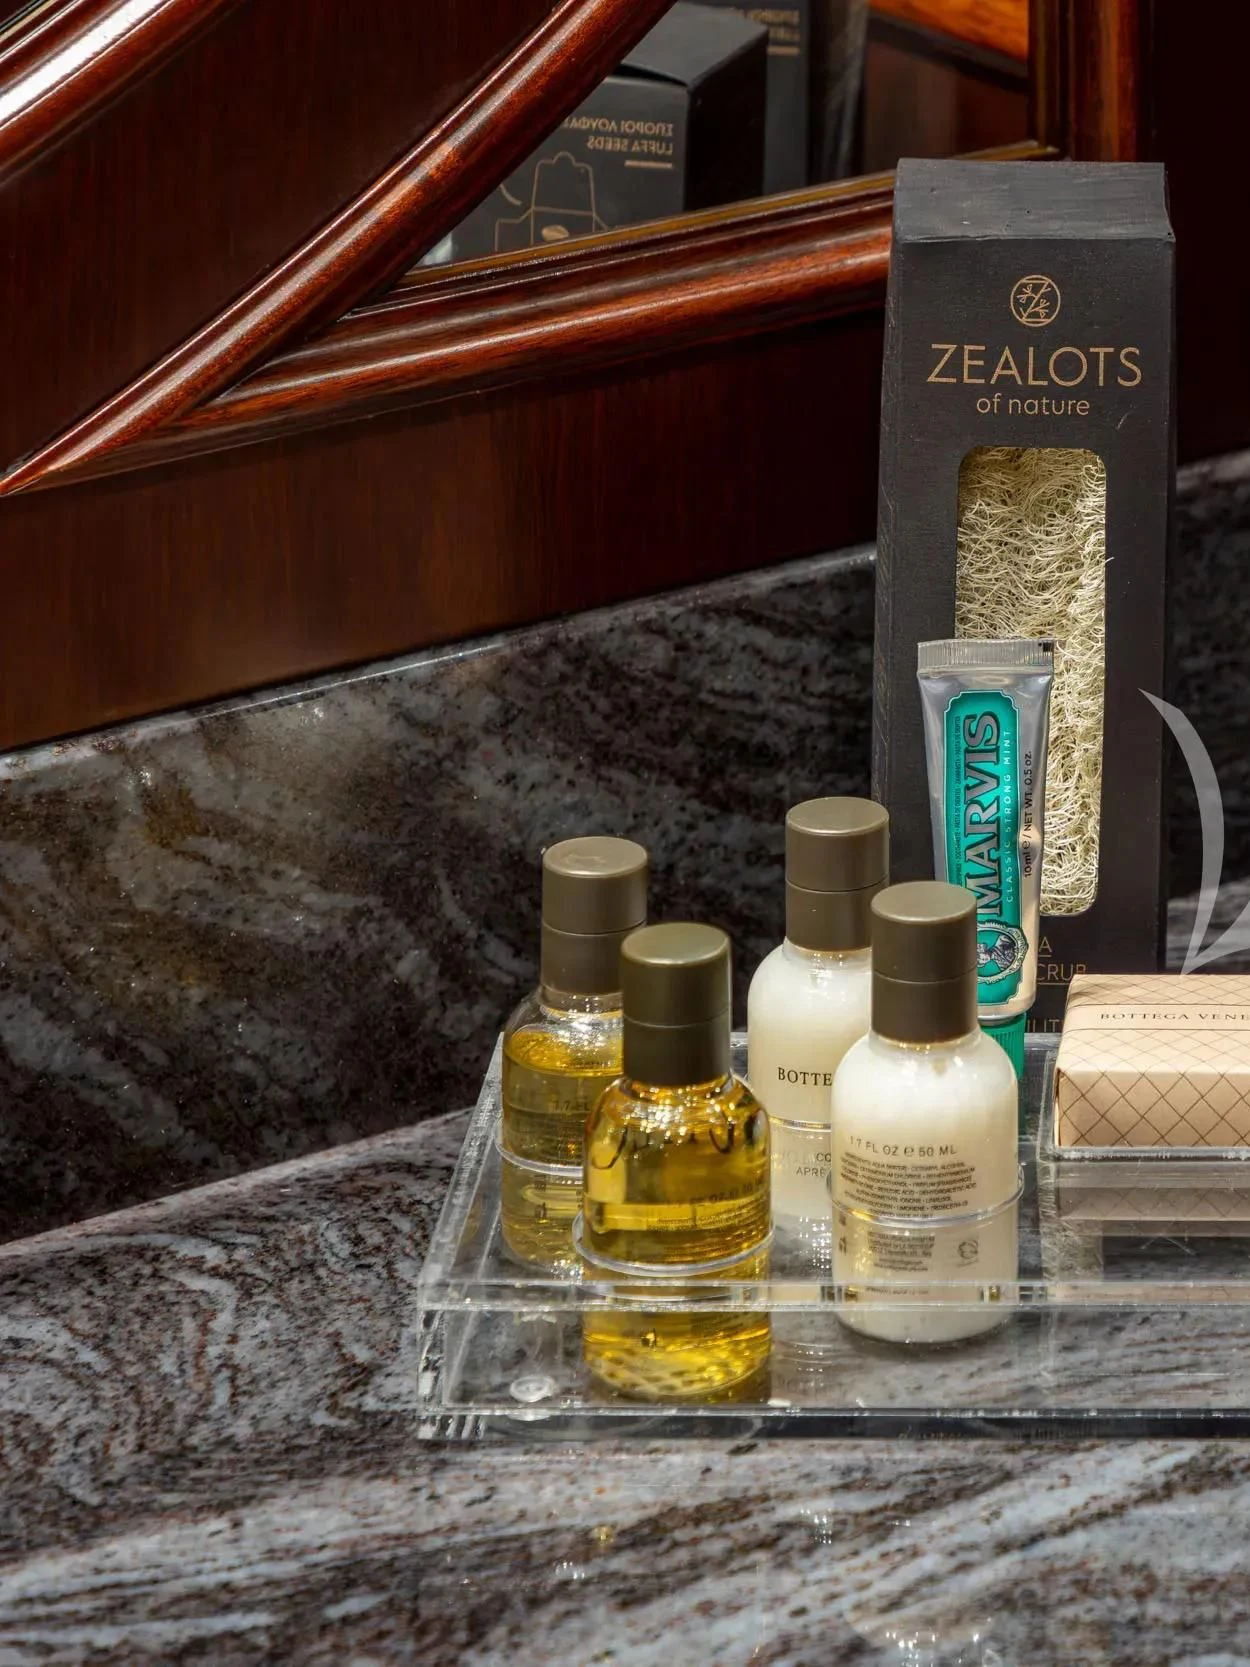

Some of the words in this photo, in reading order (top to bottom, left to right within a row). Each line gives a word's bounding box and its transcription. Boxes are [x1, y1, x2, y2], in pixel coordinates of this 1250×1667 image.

[927, 343, 1142, 387] ZEALOTS
[976, 393, 1002, 415] of
[1008, 397, 1090, 416] nature
[1003, 730, 1012, 765] MINT
[1024, 751, 1032, 767] oz.
[1023, 769, 1033, 786] 0.5
[1003, 774, 1013, 833] STRONG
[1023, 788, 1033, 809] WT.
[963, 711, 1002, 917] MARVIS
[1023, 812, 1033, 832] NET
[1003, 840, 1014, 903] CLASSIC
[1022, 851, 1033, 878] 10ml
[1100, 1013, 1188, 1021] BOTTEGA
[777, 1067, 832, 1086] BOTTE
[865, 1141, 879, 1154] FL
[883, 1145, 899, 1156] OZ
[918, 1146, 934, 1157] 50
[939, 1144, 958, 1156] ML
